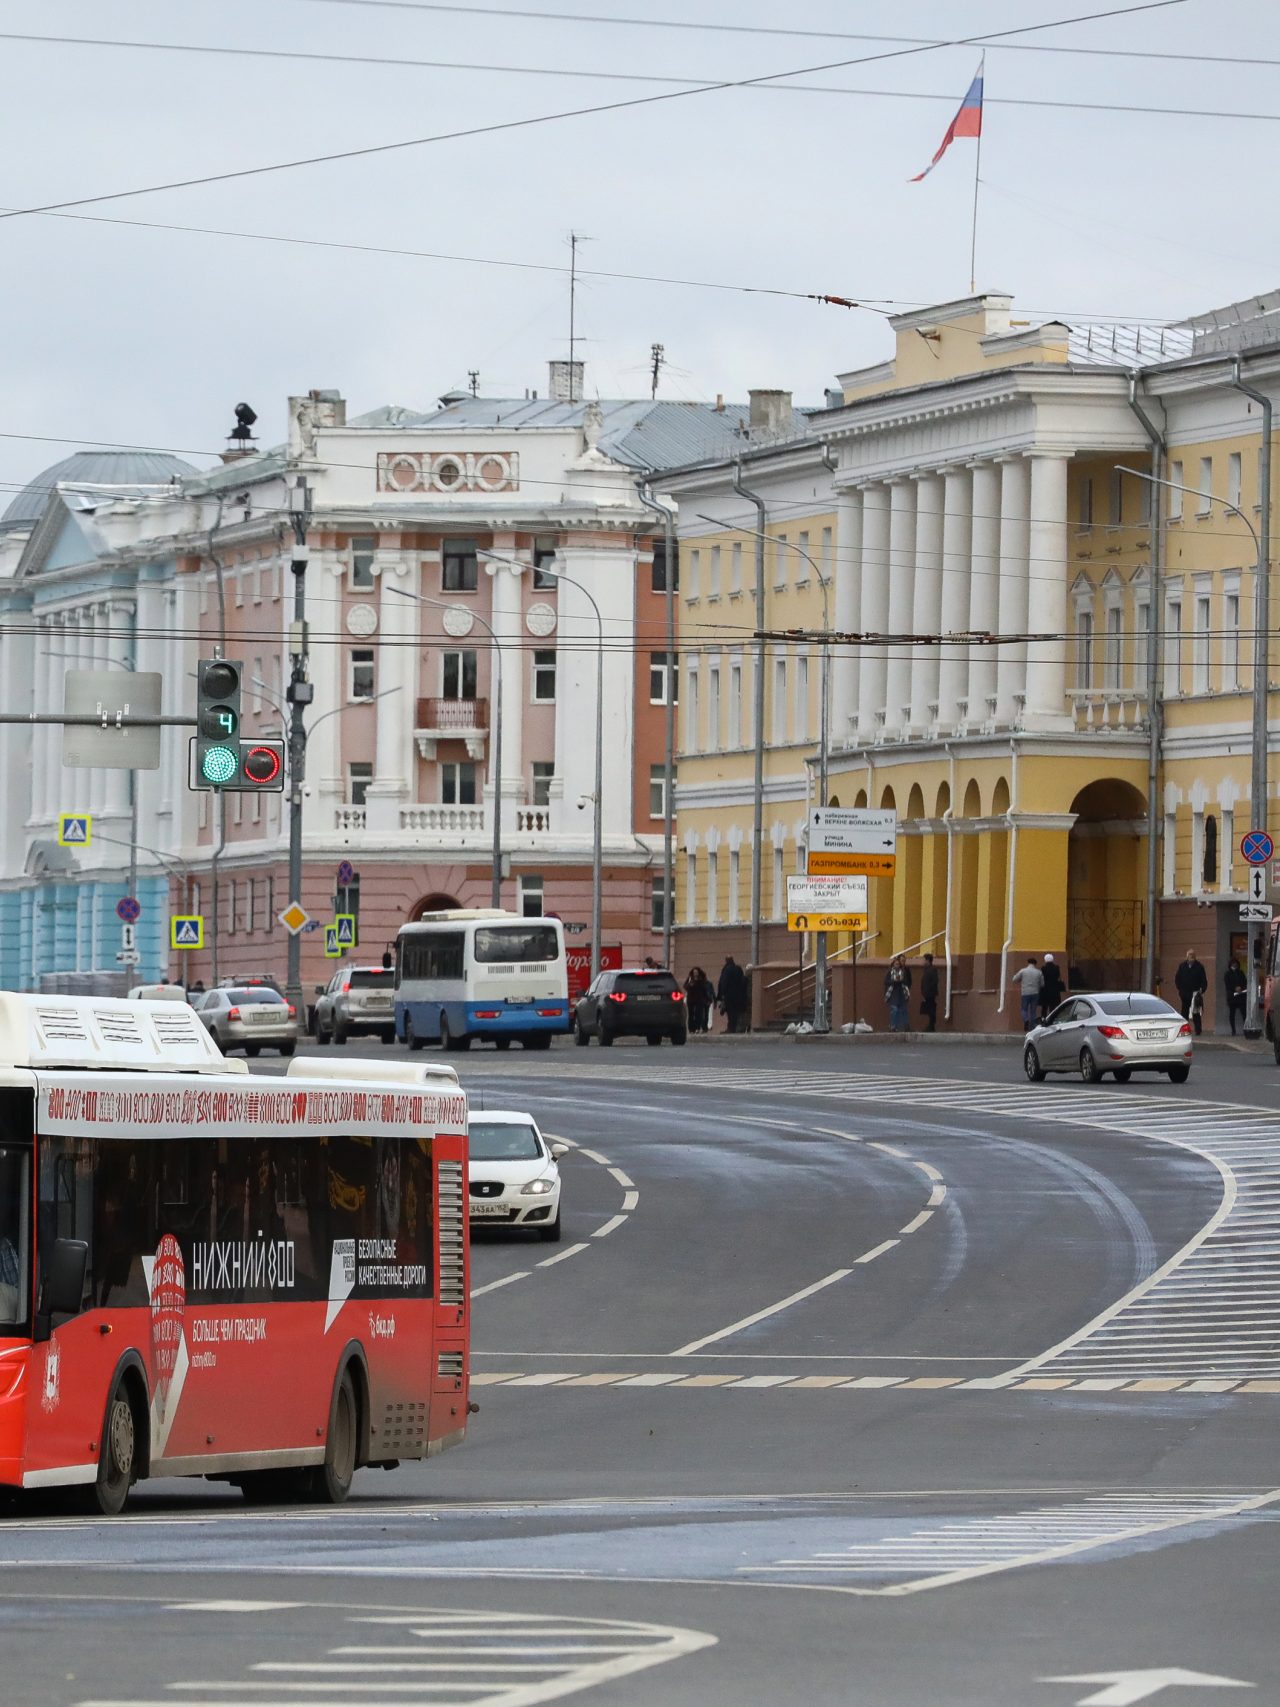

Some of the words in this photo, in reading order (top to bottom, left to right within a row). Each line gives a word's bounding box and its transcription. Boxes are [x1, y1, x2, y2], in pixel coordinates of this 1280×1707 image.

[220, 713, 232, 734] 4
[811, 860, 867, 868] ГАЗПРОМБАНК
[819, 916, 861, 927] объезд
[193, 1230, 266, 1290] НИЖНИЙ
[358, 1239, 396, 1259] БЕЗОПАСНЫЕ
[358, 1265, 403, 1286] КАЧЕСТВЕННЫЕ
[403, 1265, 427, 1289] ДОРОГИ
[192, 1319, 220, 1345] БОЛЬШЕ,
[220, 1318, 234, 1341] ЧЕМ
[234, 1317, 267, 1344] ПРАЗДНИК
[375, 1313, 396, 1338] бкд.рф
